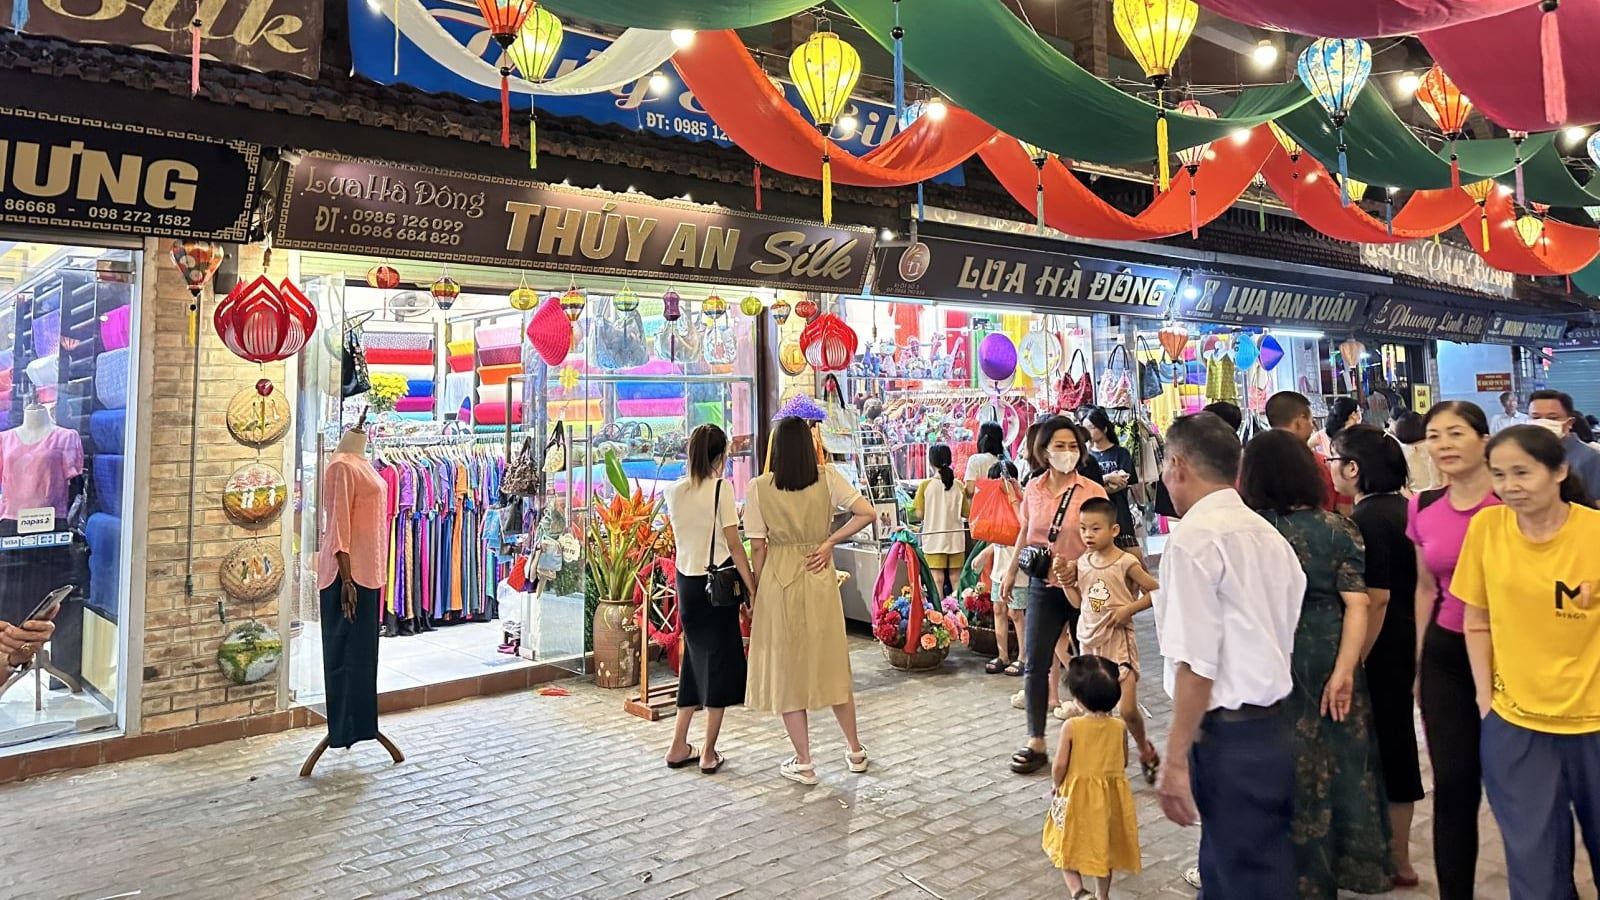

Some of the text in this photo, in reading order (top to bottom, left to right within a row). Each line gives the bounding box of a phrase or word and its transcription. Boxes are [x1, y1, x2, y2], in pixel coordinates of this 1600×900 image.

[646, 112, 670, 130] ĐT:
[673, 117, 708, 136] 0985
[0, 139, 199, 211] ƯNG
[4, 198, 56, 214] 86668
[88, 206, 118, 219] 098
[123, 210, 152, 223] 272
[157, 214, 191, 227] 1582
[414, 180, 486, 218] Đông
[350, 223, 460, 246] 0986 684 820
[352, 209, 396, 225] 0985
[402, 214, 429, 229] 126
[432, 218, 464, 232] 099
[505, 201, 853, 281] THÚY AN Silk
[957, 256, 1170, 307] LỤA HÀ ĐÔNG
[1303, 292, 1358, 323] XUÂN
[21, 518, 44, 527] napas
